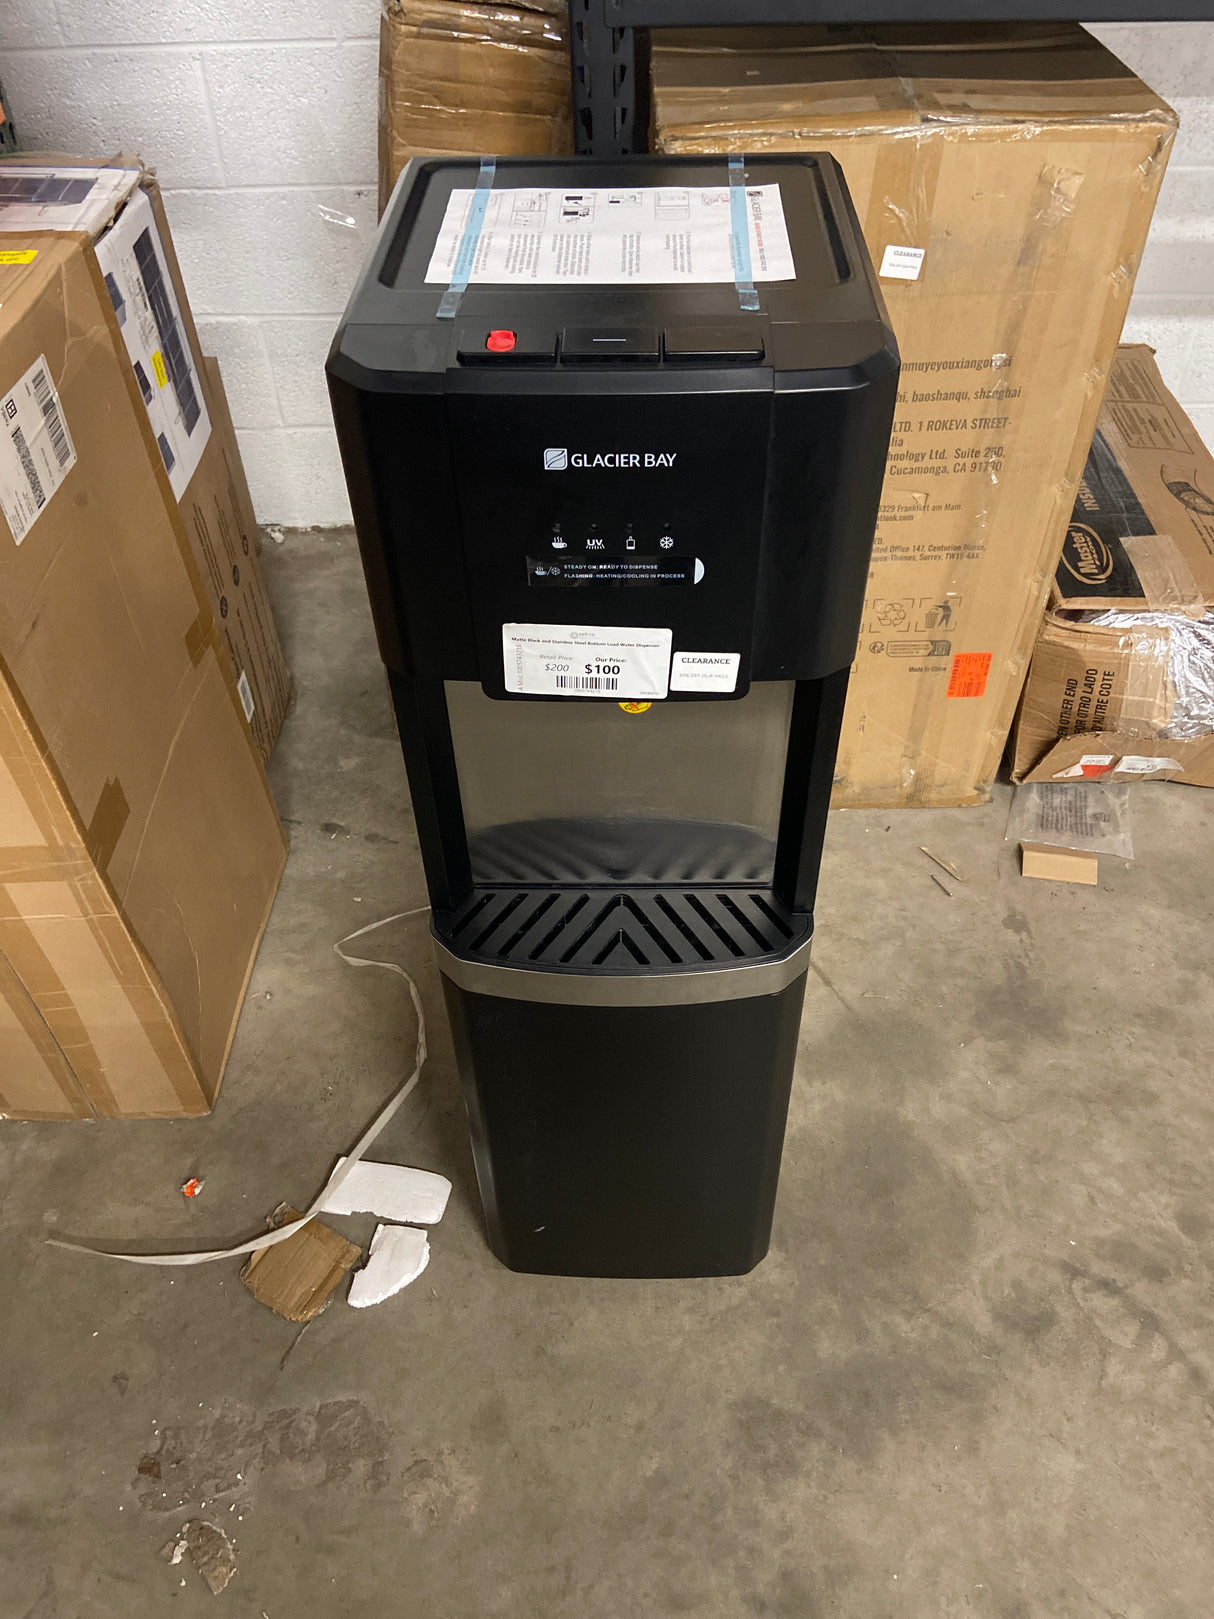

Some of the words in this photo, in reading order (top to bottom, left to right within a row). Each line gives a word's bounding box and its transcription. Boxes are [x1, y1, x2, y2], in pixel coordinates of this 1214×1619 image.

[918, 421, 923, 432] 1
[926, 419, 967, 431] ROKEVA
[571, 453, 641, 468] GLACIER
[644, 453, 676, 467] BAY
[929, 449, 947, 460] Ltd.
[954, 448, 980, 459] Suite
[953, 462, 966, 473] CA
[897, 503, 930, 512] Frankfurt
[1070, 531, 1099, 573] Master
[1084, 535, 1101, 566] FLOW
[544, 663, 569, 672] $200
[585, 663, 620, 675] $100
[1064, 678, 1078, 697] END
[1082, 668, 1098, 695] LADO
[1098, 670, 1115, 697] COTE
[1059, 698, 1074, 725] OTHER
[1077, 696, 1091, 718] OTRO
